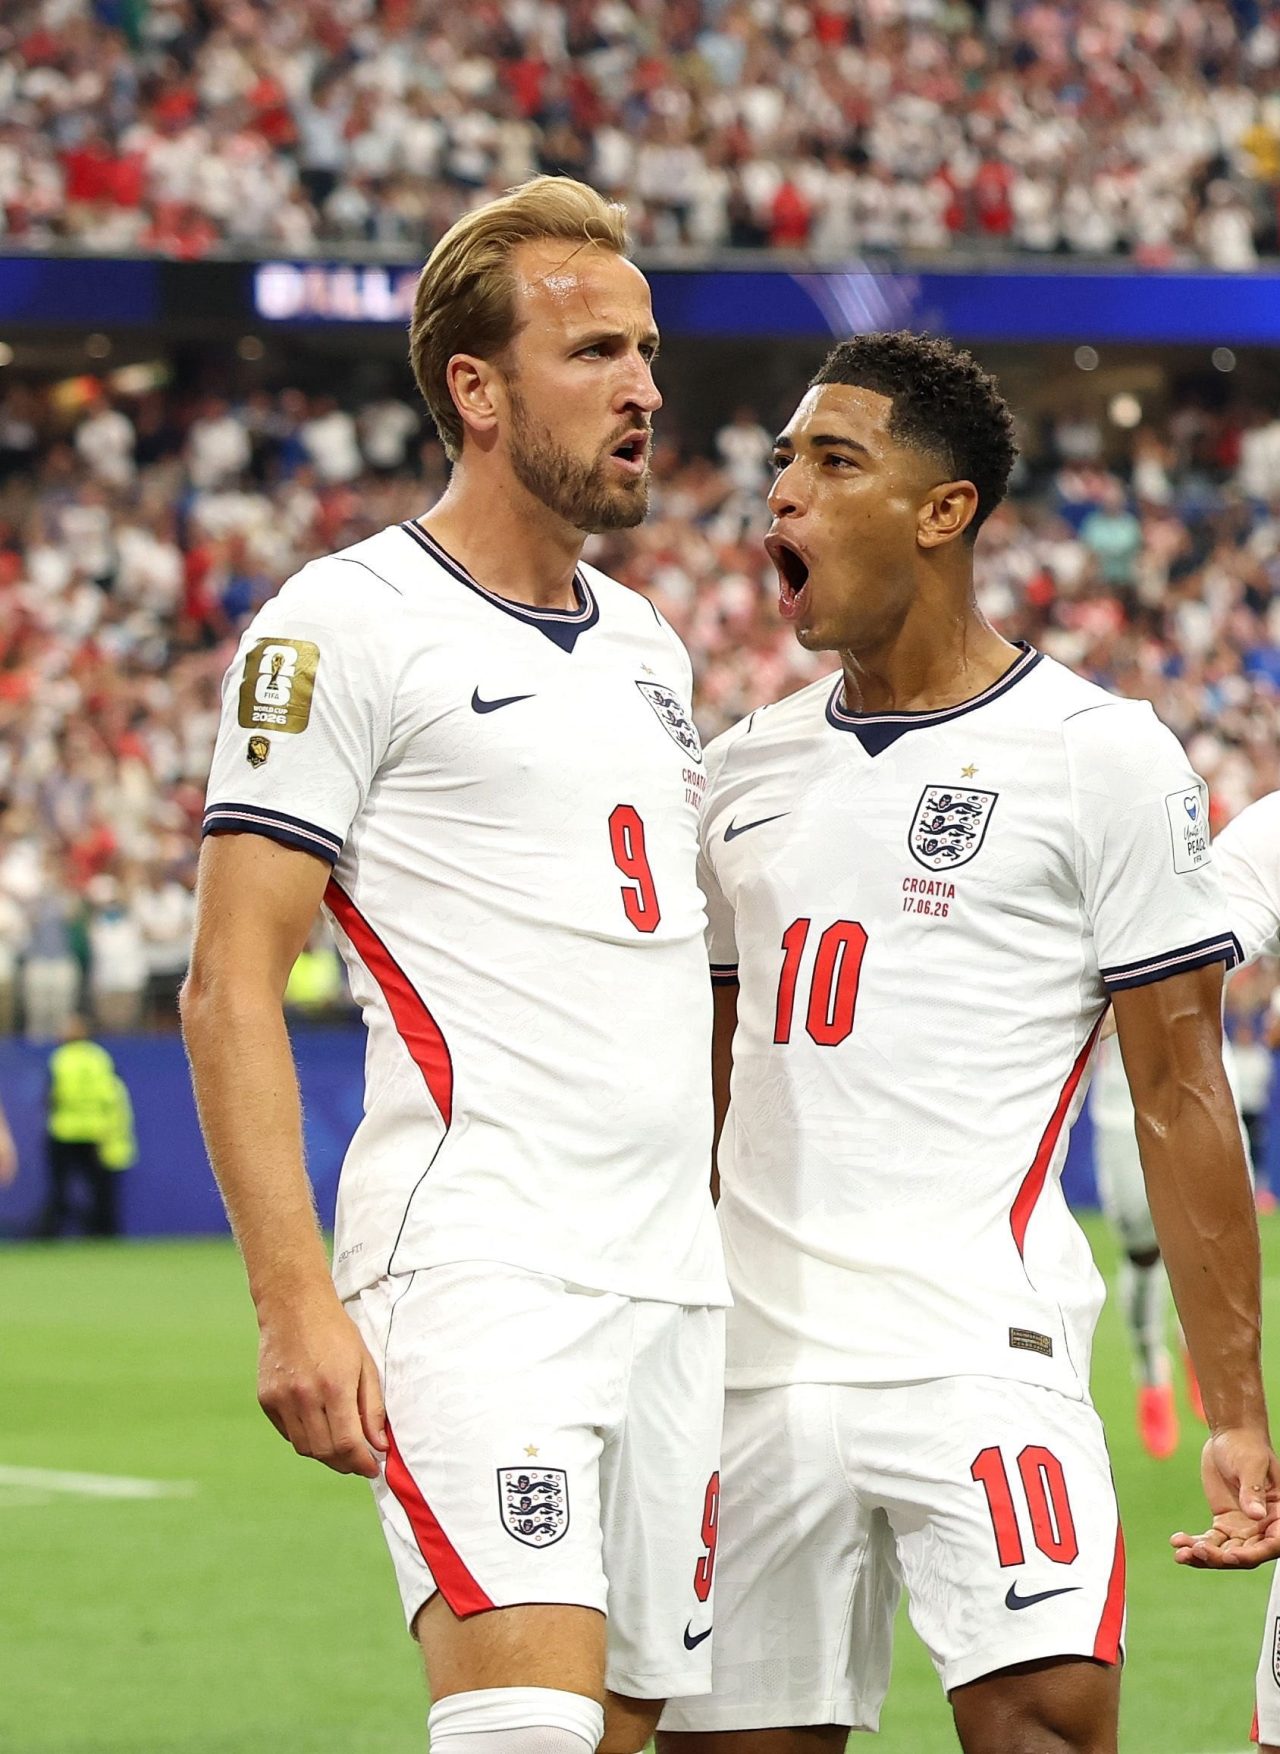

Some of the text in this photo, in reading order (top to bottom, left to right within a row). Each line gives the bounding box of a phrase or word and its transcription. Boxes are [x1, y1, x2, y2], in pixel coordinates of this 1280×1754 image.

[264, 692, 280, 700] FIFA
[252, 712, 287, 725] 2026
[253, 705, 288, 715] WORLD CUP
[608, 804, 661, 933] 9
[902, 877, 955, 899] CROATIA
[902, 896, 949, 918] 17.06.26
[773, 917, 869, 1047] 10
[970, 1444, 1080, 1568] 10
[693, 1470, 720, 1603] 9
